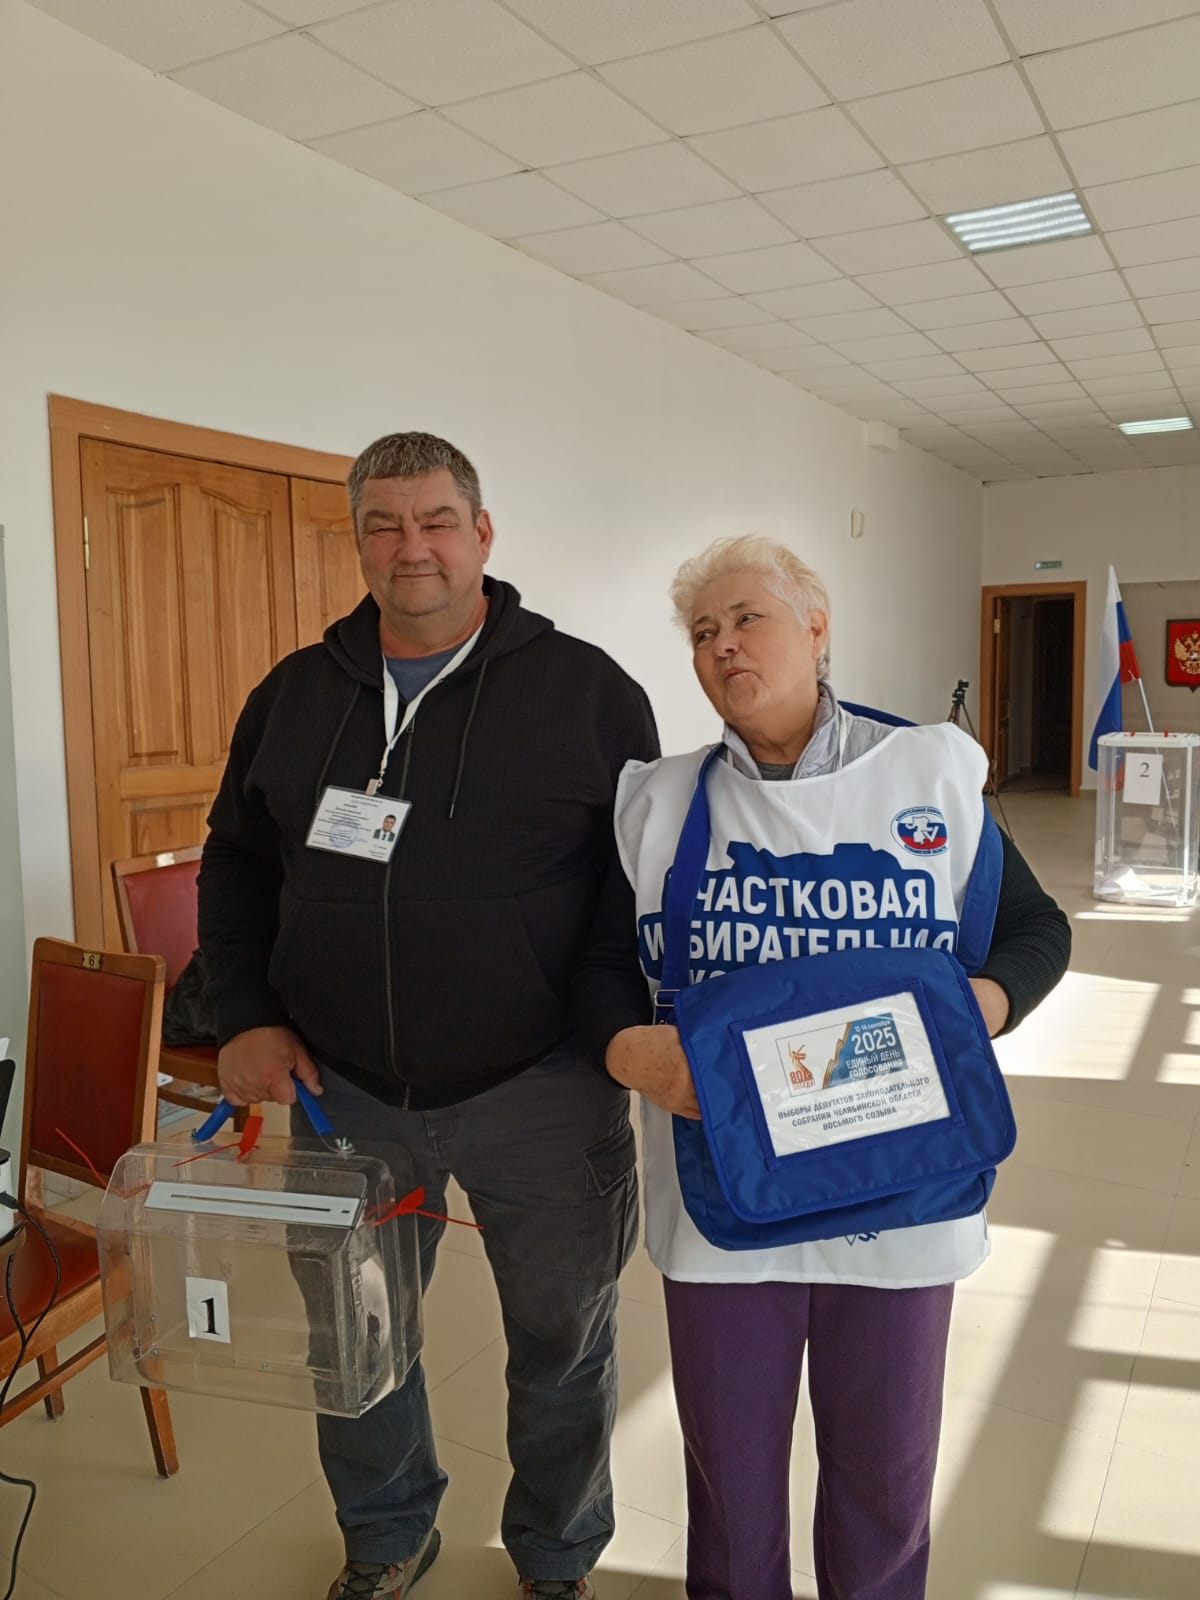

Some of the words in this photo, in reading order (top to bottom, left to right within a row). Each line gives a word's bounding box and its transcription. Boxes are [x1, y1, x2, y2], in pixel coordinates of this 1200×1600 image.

[1139, 761, 1150, 778] 2
[669, 874, 928, 920] ЧАСТКОВАЯ
[643, 920, 954, 964] ИБИРАТЕЛЬНАЯ
[851, 1026, 897, 1056] 2025
[846, 1052, 879, 1070] ЕДИНЫЙ
[879, 1049, 901, 1063] ДЕНЬ
[778, 1104, 812, 1120] ВЫБОРЫ
[814, 1095, 854, 1112] ДЕПУТАТОВ
[792, 1111, 832, 1127] СОБРАНИЯ
[822, 1114, 864, 1131] ВОСЬМОГО
[865, 1106, 897, 1120] СОЗЫВА
[200, 1296, 222, 1336] 1
